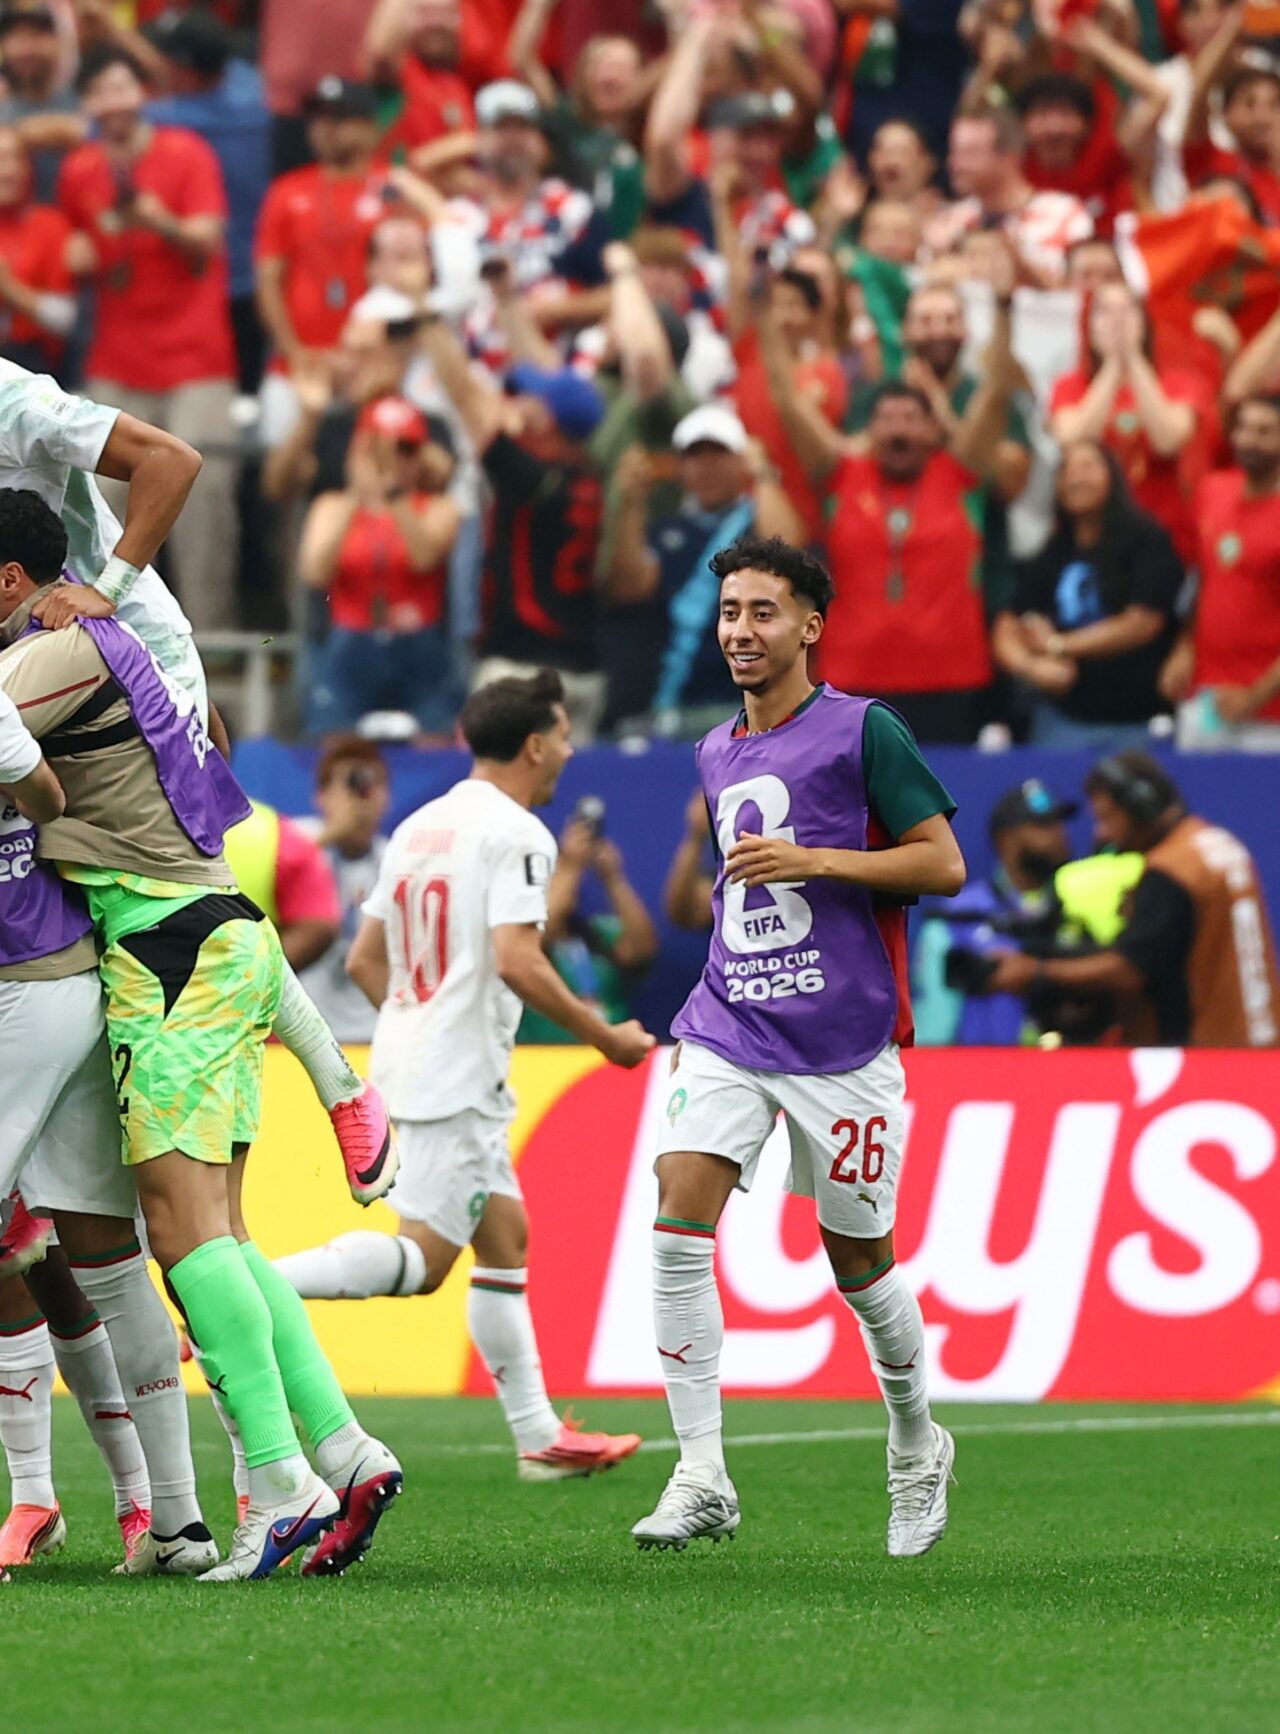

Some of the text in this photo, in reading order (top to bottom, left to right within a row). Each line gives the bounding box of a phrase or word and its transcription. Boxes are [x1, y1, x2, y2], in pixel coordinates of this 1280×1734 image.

[392, 875, 450, 1003] 10
[742, 914, 787, 939] FIFA
[723, 948, 821, 978] WORLD CUP
[725, 967, 826, 1004] 2026
[829, 1115, 888, 1185] 26
